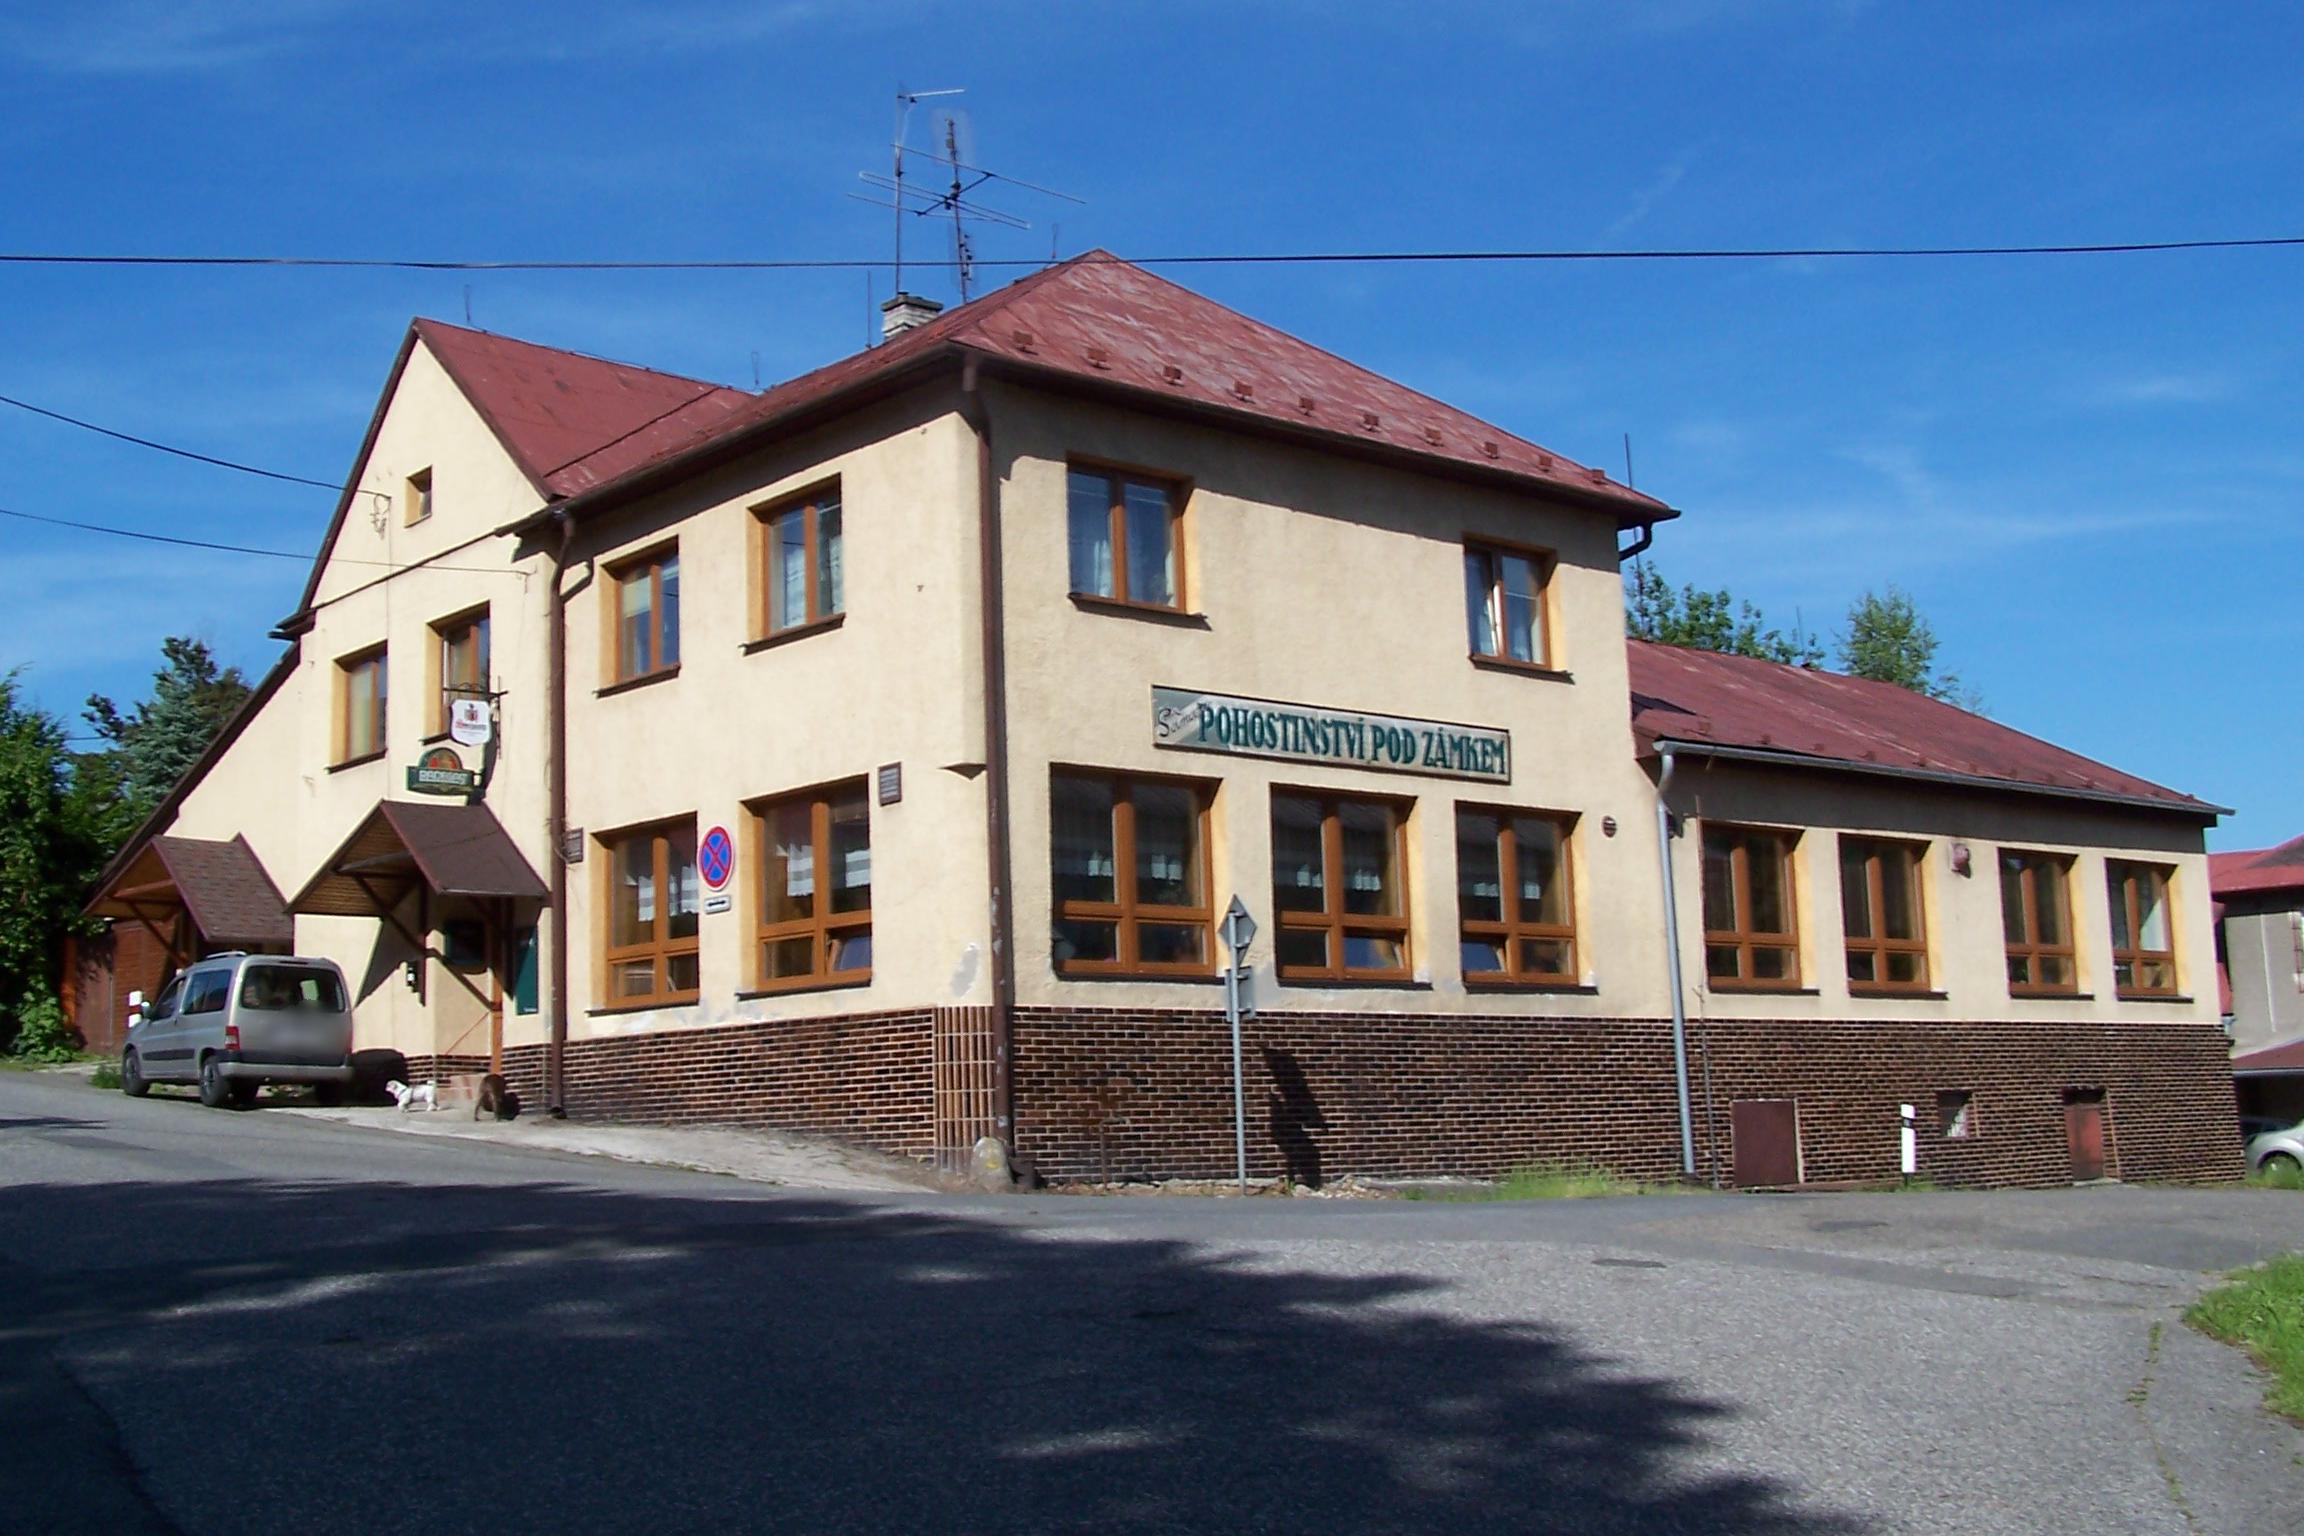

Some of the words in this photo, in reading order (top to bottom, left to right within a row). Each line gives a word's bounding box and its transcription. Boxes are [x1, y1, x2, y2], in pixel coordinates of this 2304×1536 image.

[1198, 702, 1365, 760] POHOSTINSTVÍ
[1371, 724, 1417, 764] POD
[1421, 726, 1506, 775] ZÁMKEM
